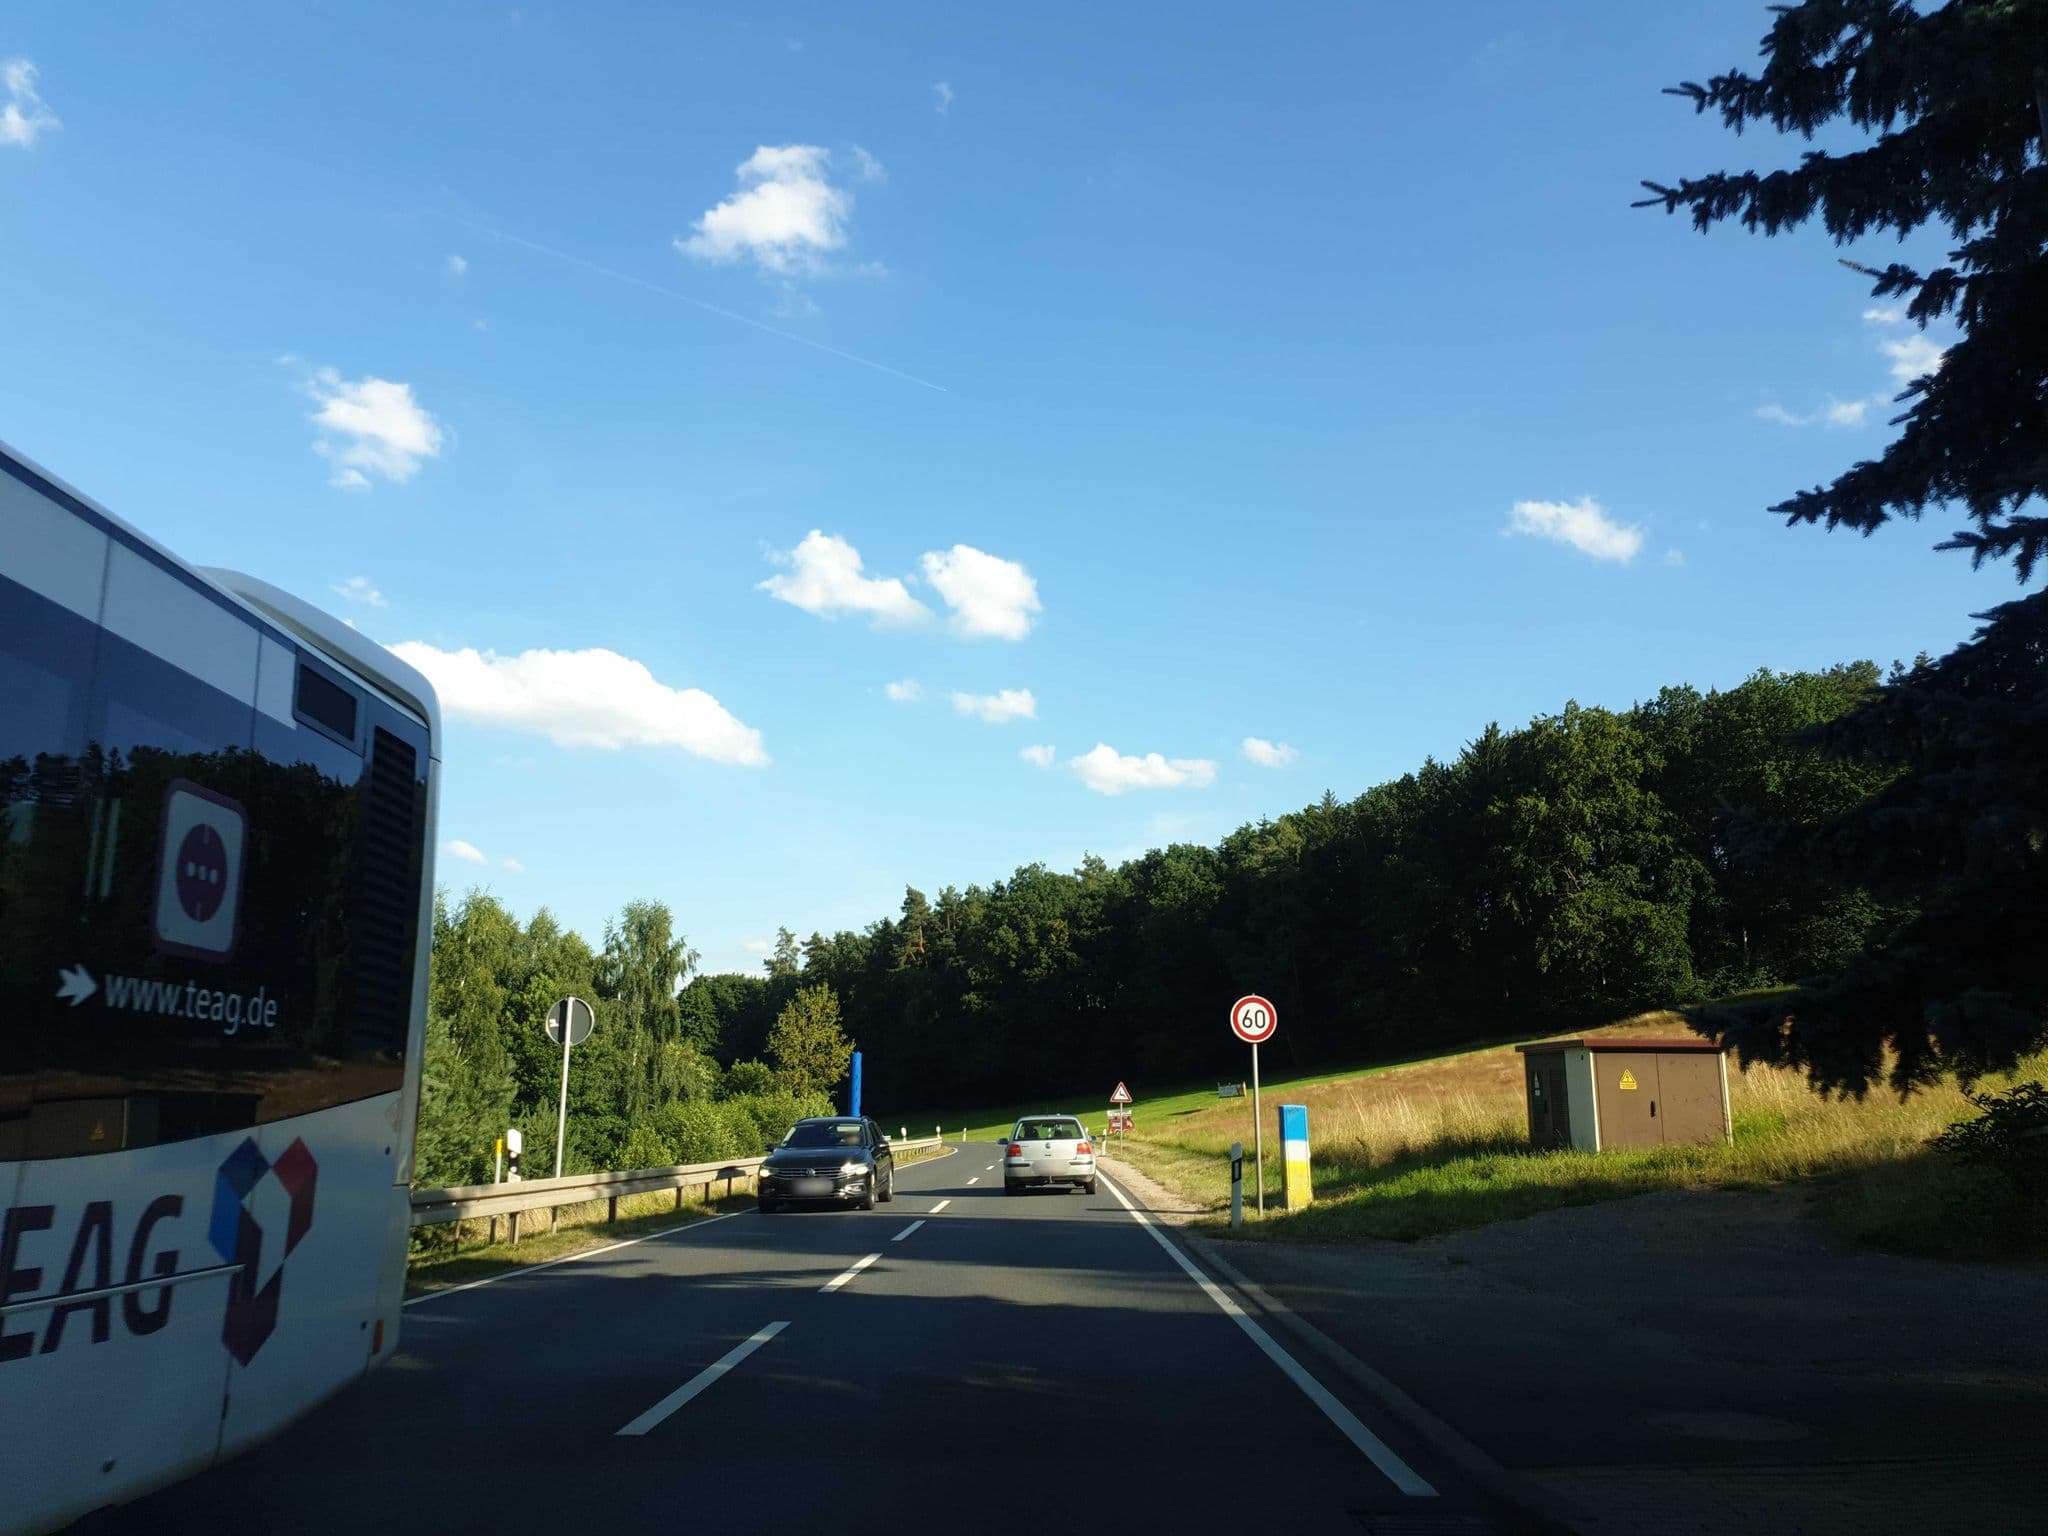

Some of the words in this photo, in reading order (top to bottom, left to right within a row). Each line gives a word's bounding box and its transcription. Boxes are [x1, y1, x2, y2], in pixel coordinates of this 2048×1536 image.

[104, 973, 278, 1036] www.teag.de
[1242, 1009, 1266, 1029] 60
[0, 1194, 185, 1363] EAG
